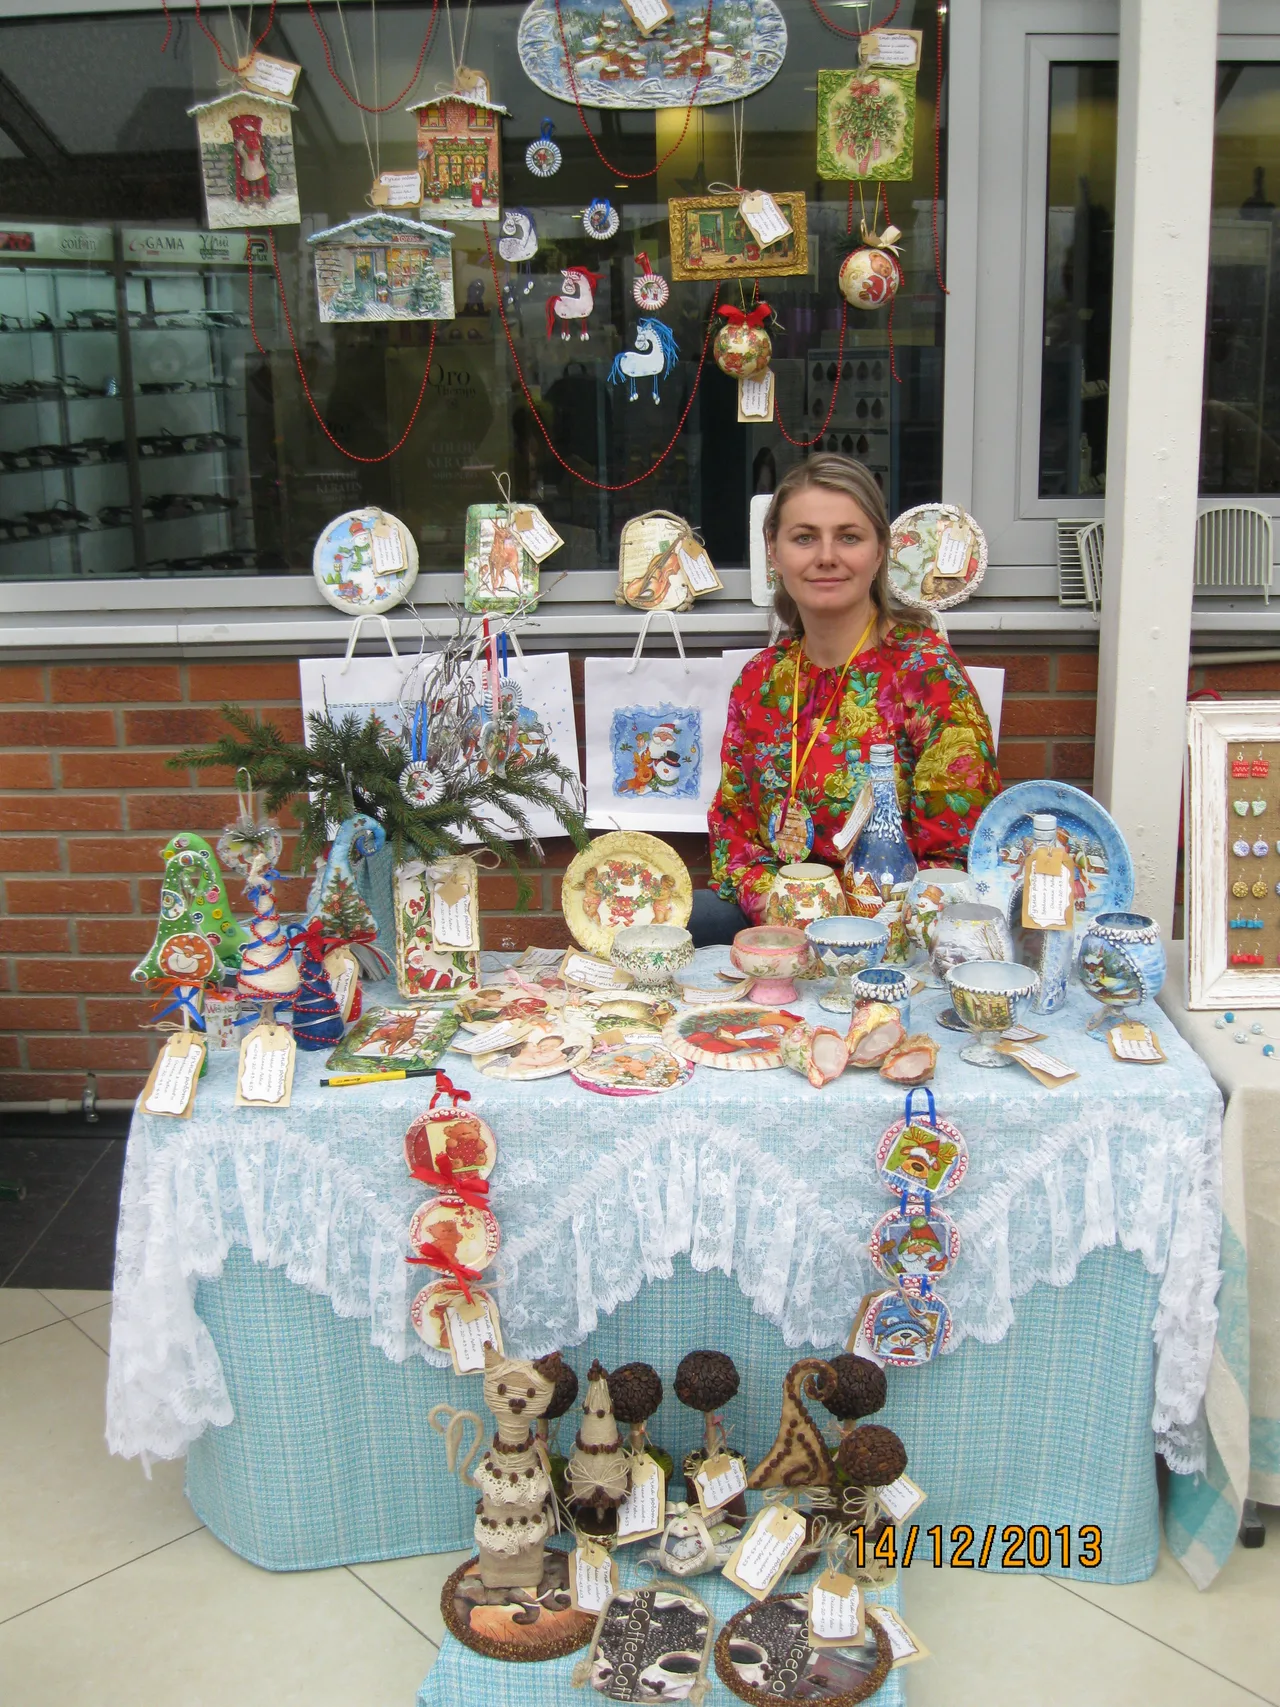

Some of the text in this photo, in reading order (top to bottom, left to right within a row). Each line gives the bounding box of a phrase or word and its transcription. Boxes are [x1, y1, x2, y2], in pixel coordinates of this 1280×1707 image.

[146, 237, 185, 250] GAMA
[427, 364, 471, 387] Oro
[760, 1530, 800, 1587] Ручна робота
